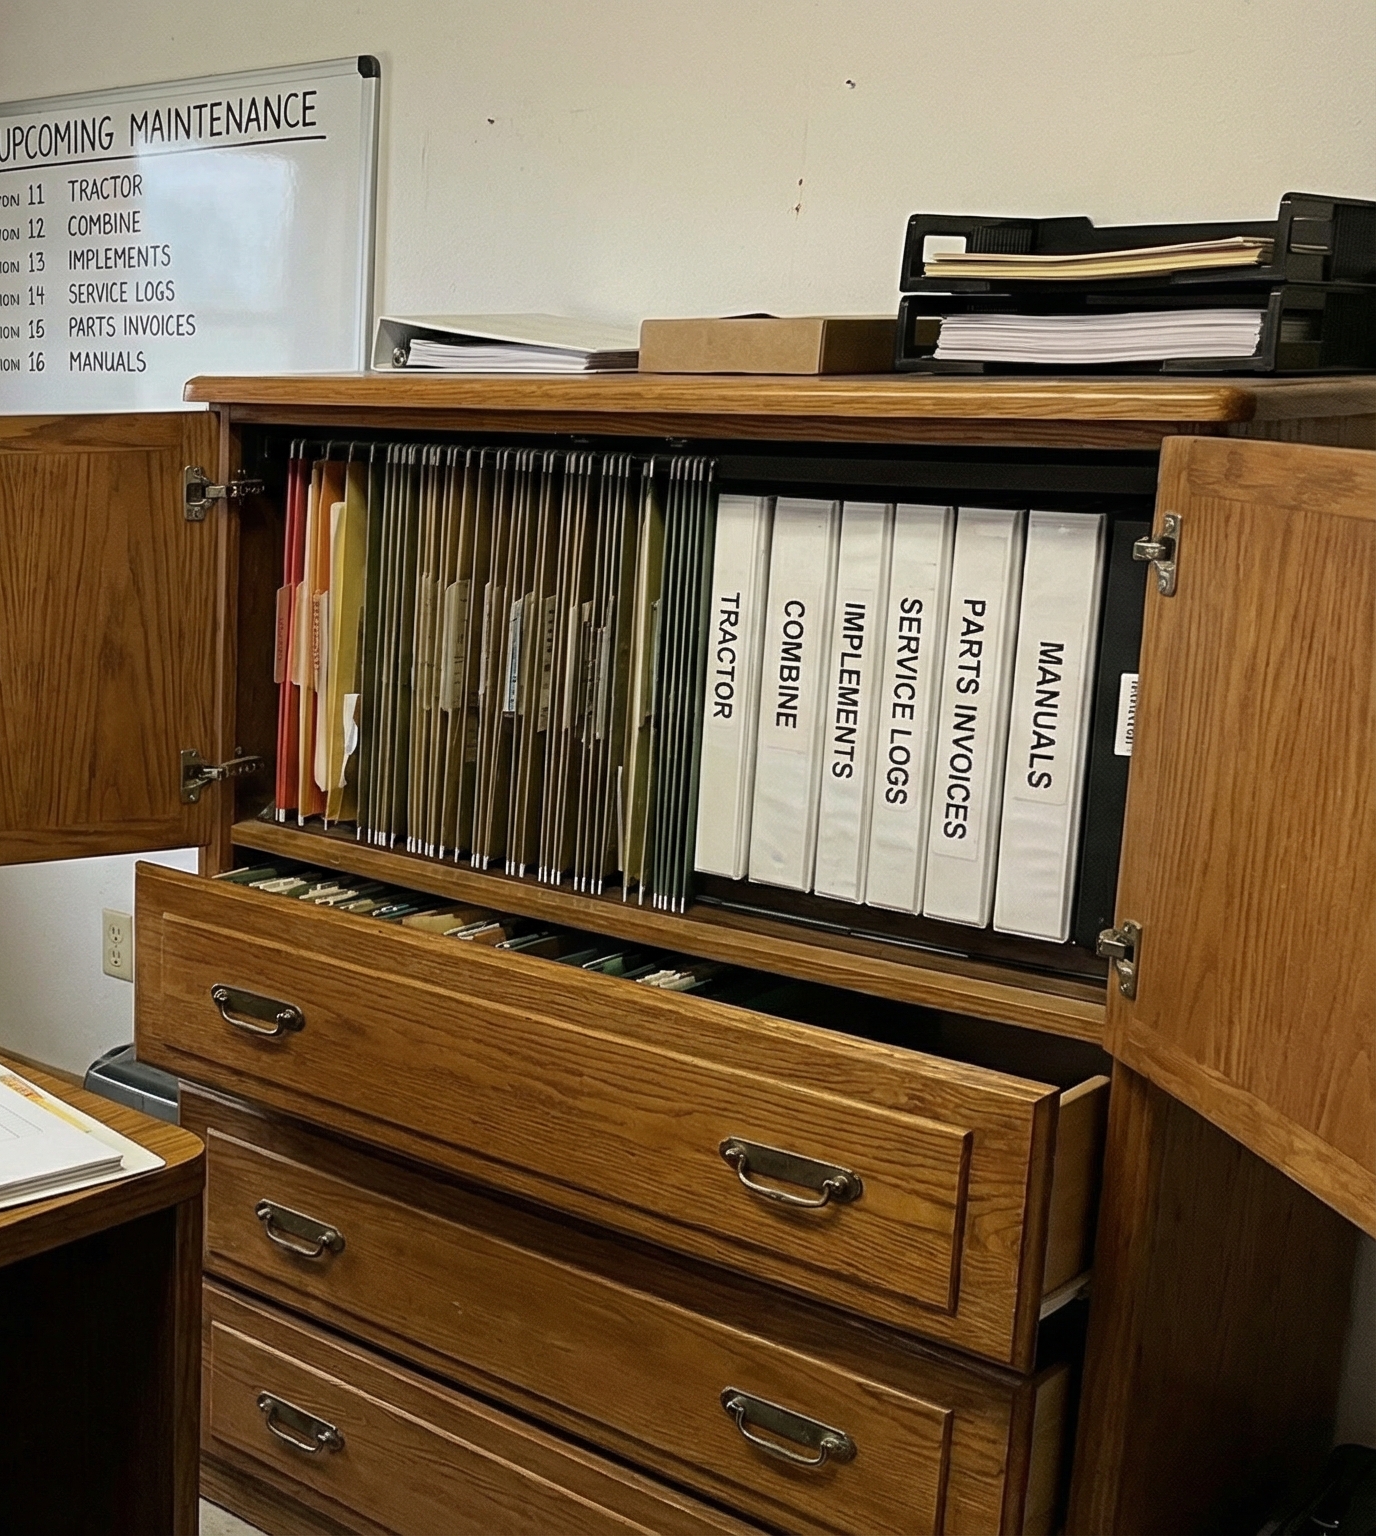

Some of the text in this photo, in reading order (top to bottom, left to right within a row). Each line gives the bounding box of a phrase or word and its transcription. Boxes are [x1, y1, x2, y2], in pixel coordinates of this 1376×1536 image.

[130, 90, 318, 147] MAINTENANCE
[28, 183, 45, 206] 11
[68, 174, 143, 202] TRACTOR
[28, 217, 46, 239] 12
[68, 211, 141, 237] COMBINE
[28, 251, 46, 272] 13
[68, 245, 171, 271] IMPLEMENTS
[28, 285, 45, 306] 14
[69, 281, 128, 304] SERVICE
[135, 280, 175, 302] LOGS
[28, 318, 45, 339] 15
[69, 316, 116, 338] PARTS
[123, 314, 196, 337] INVOICES
[28, 350, 46, 372] 16
[69, 350, 147, 373] MANUALS
[712, 592, 741, 719] TRACTOR
[775, 600, 806, 729] COMBINE
[831, 602, 866, 779] IMPLEMENTS
[885, 597, 924, 805] SERVICE LOGS
[1027, 641, 1065, 789] MANUALS
[943, 599, 987, 840] PARTS INVOICES
